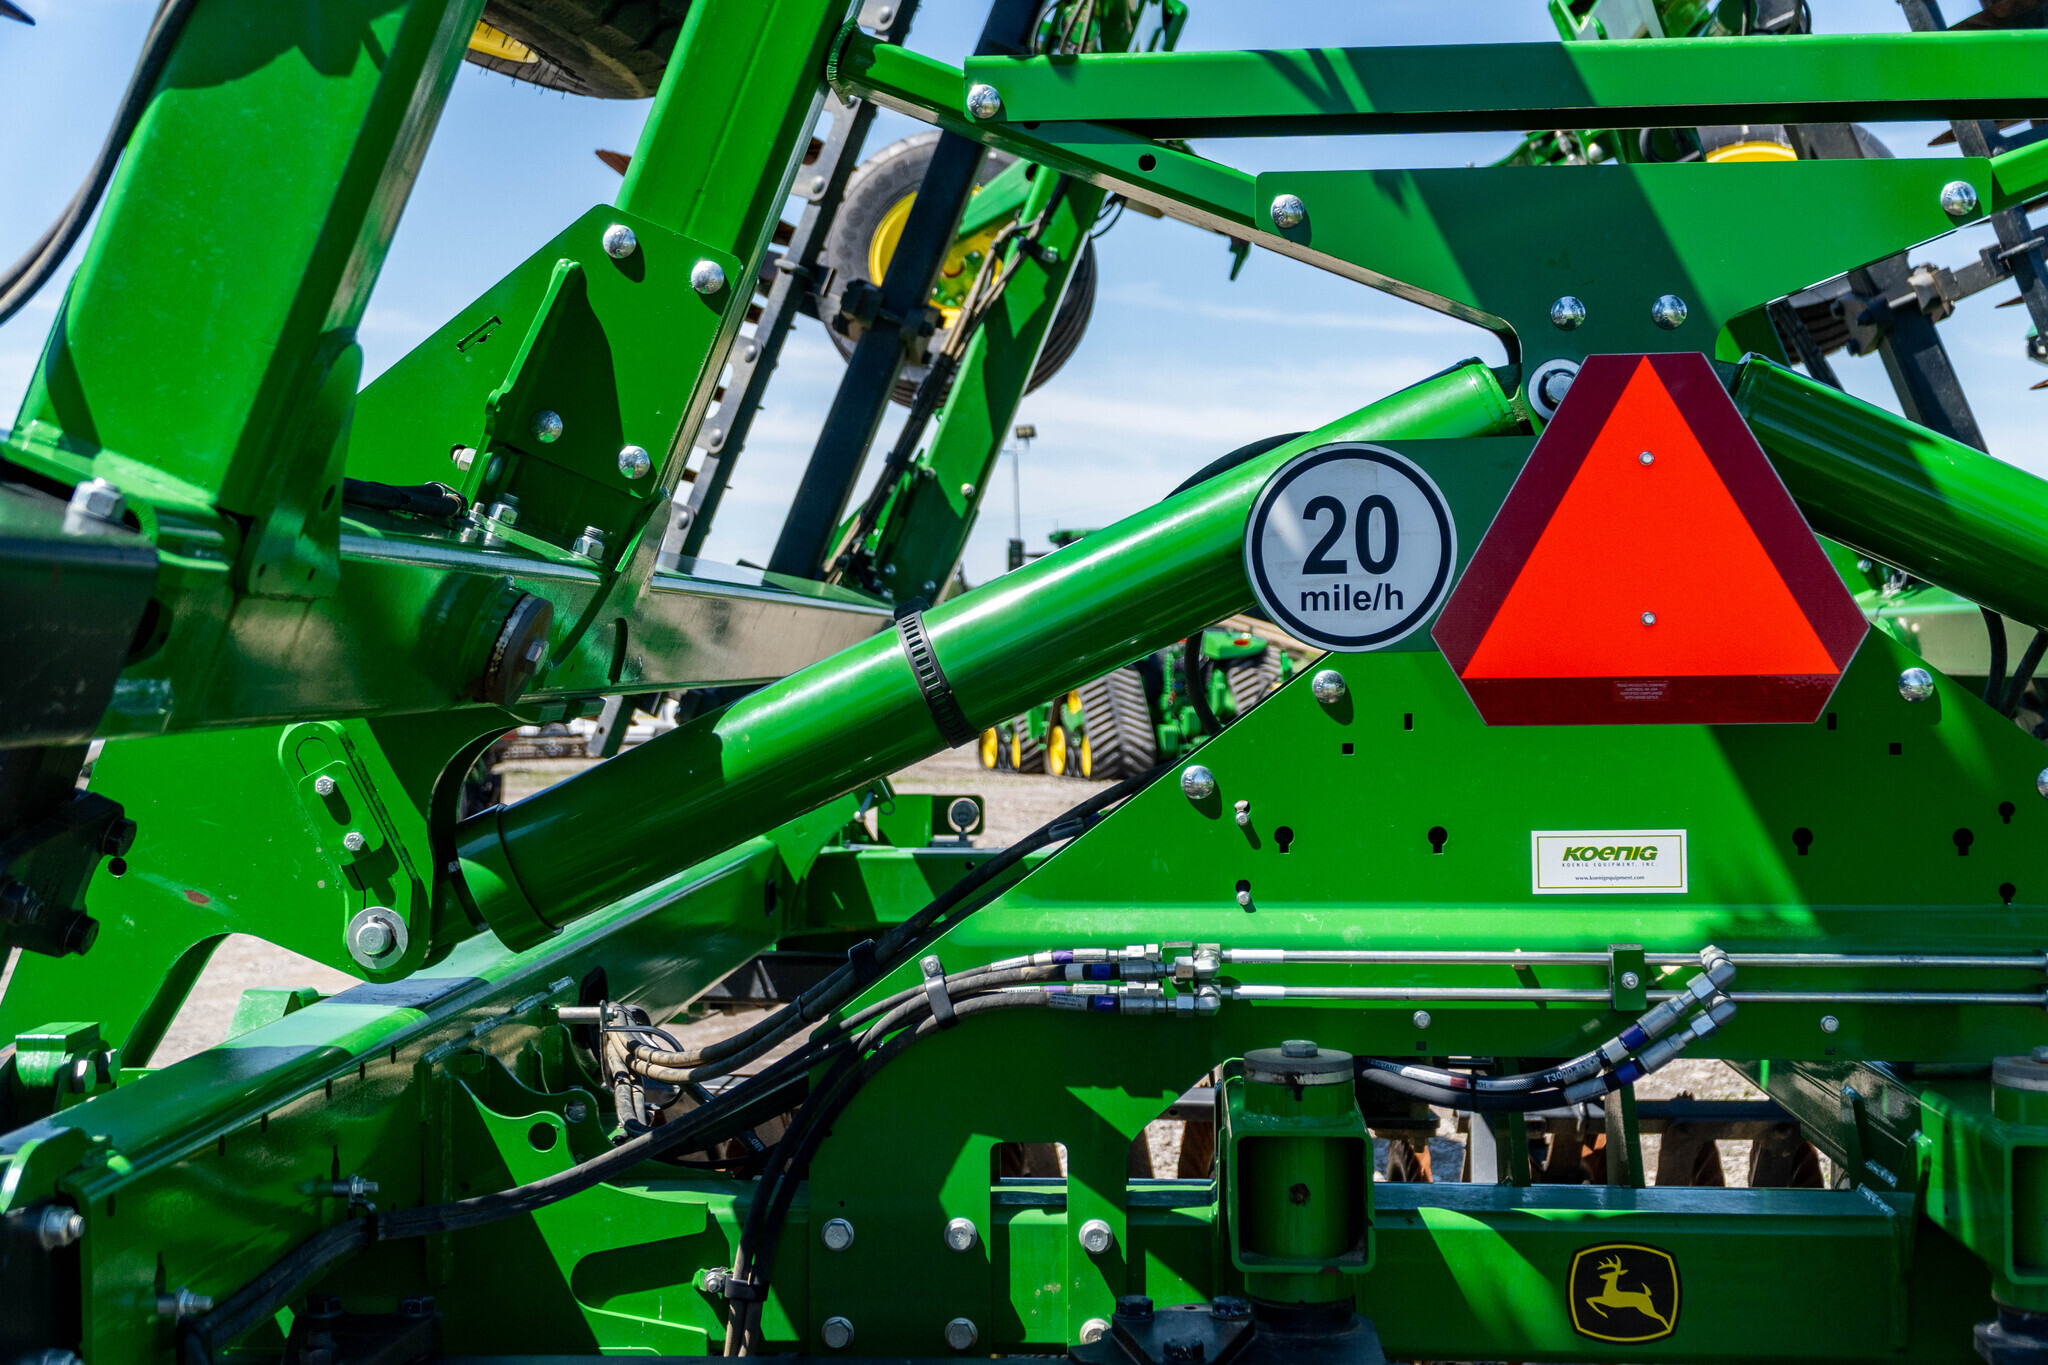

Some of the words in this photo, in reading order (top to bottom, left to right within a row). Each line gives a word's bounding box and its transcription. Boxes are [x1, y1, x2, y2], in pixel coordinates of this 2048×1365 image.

[1302, 494, 1399, 575] 20
[1301, 583, 1404, 612] mile/h
[1575, 874, 1645, 882] www.koenigequipment.com
